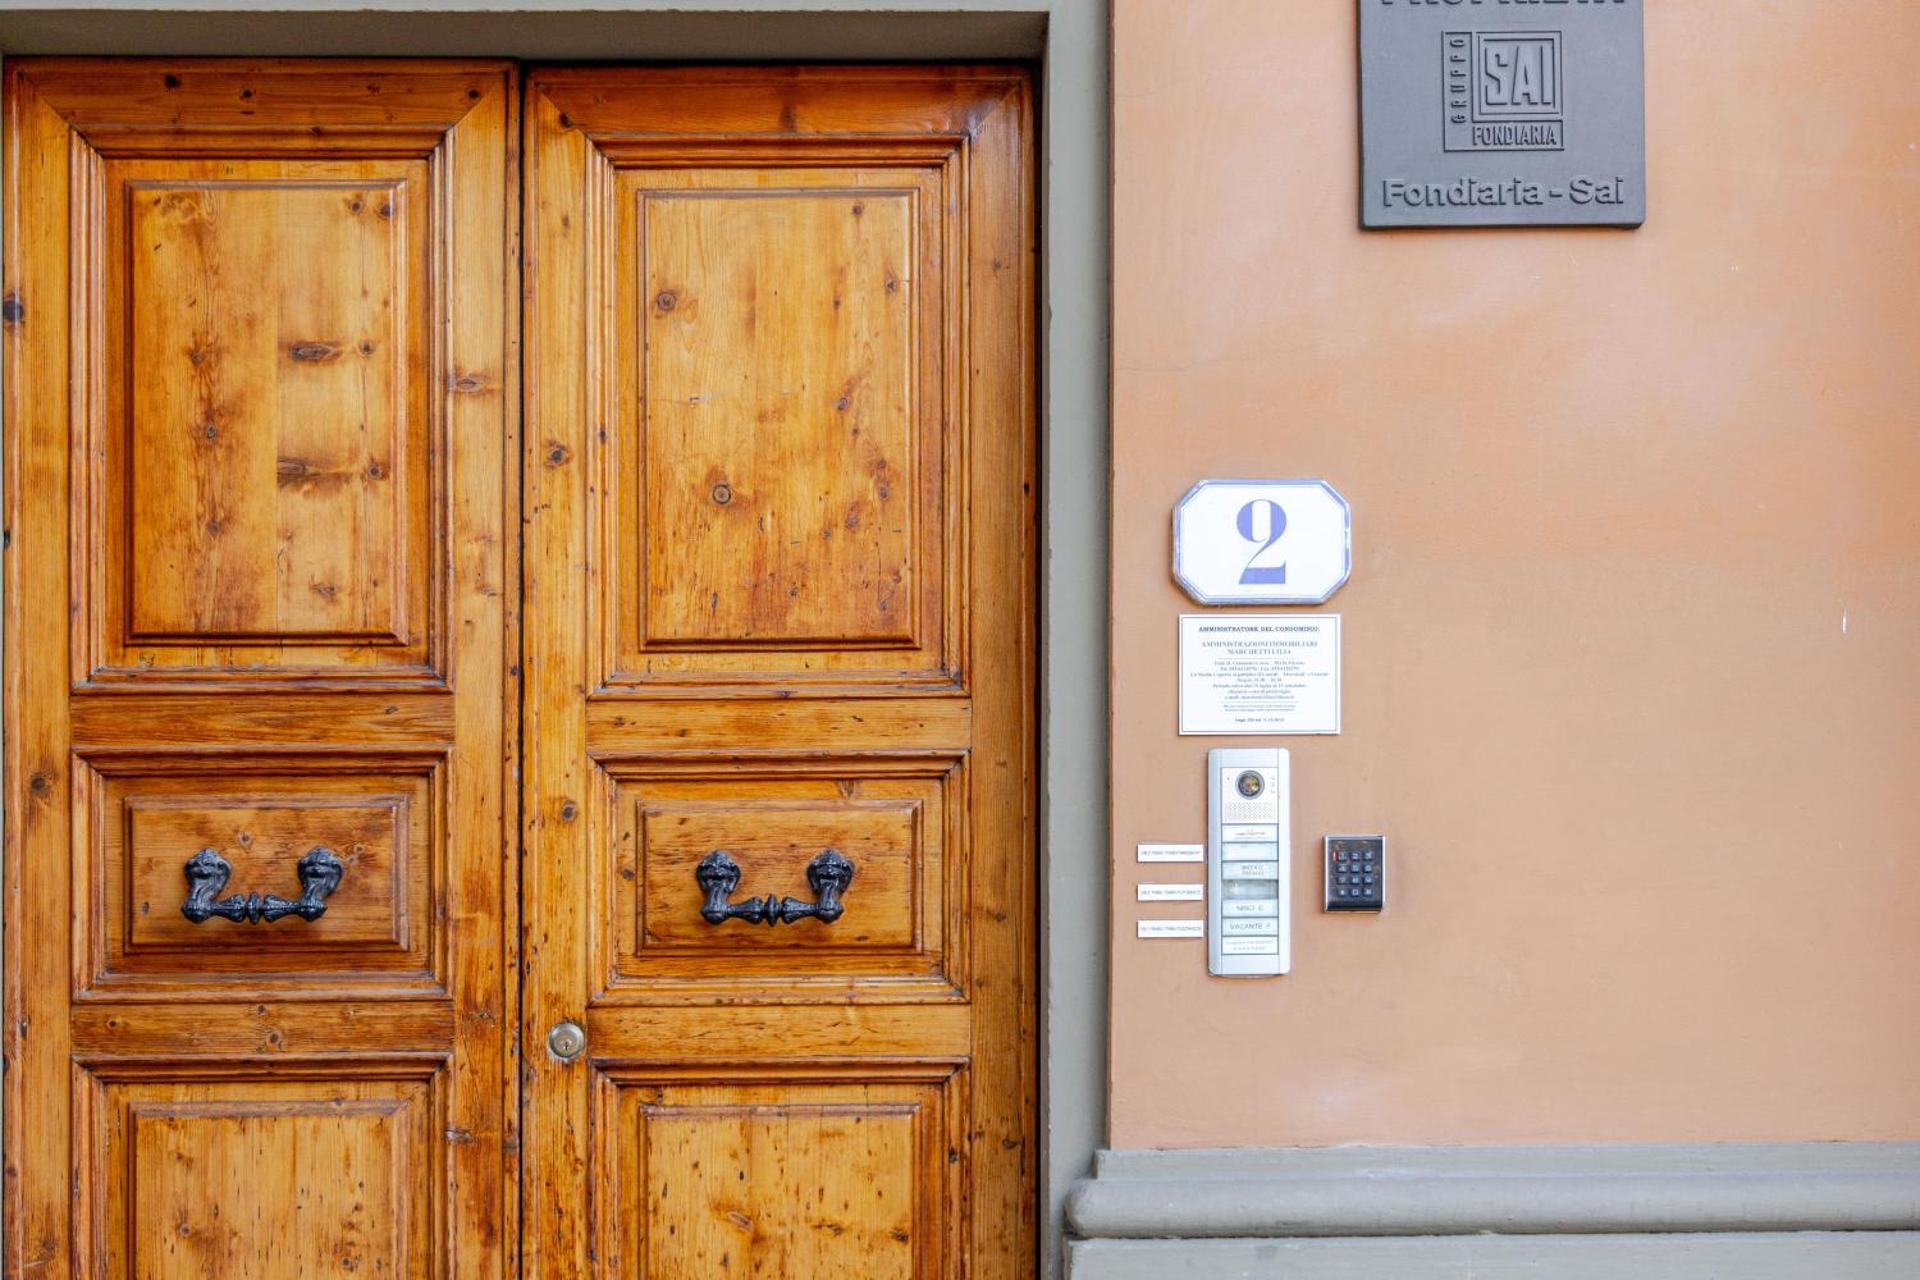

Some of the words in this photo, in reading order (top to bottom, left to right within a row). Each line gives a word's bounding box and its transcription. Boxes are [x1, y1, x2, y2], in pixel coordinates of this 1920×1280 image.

[1450, 39, 1467, 125] GRUPPO
[1484, 45, 1553, 106] SAI
[1472, 125, 1557, 147] FONDIARIA
[1383, 177, 1543, 207] Fondiaria
[1569, 174, 1624, 206] Sai
[1235, 499, 1287, 585] 2
